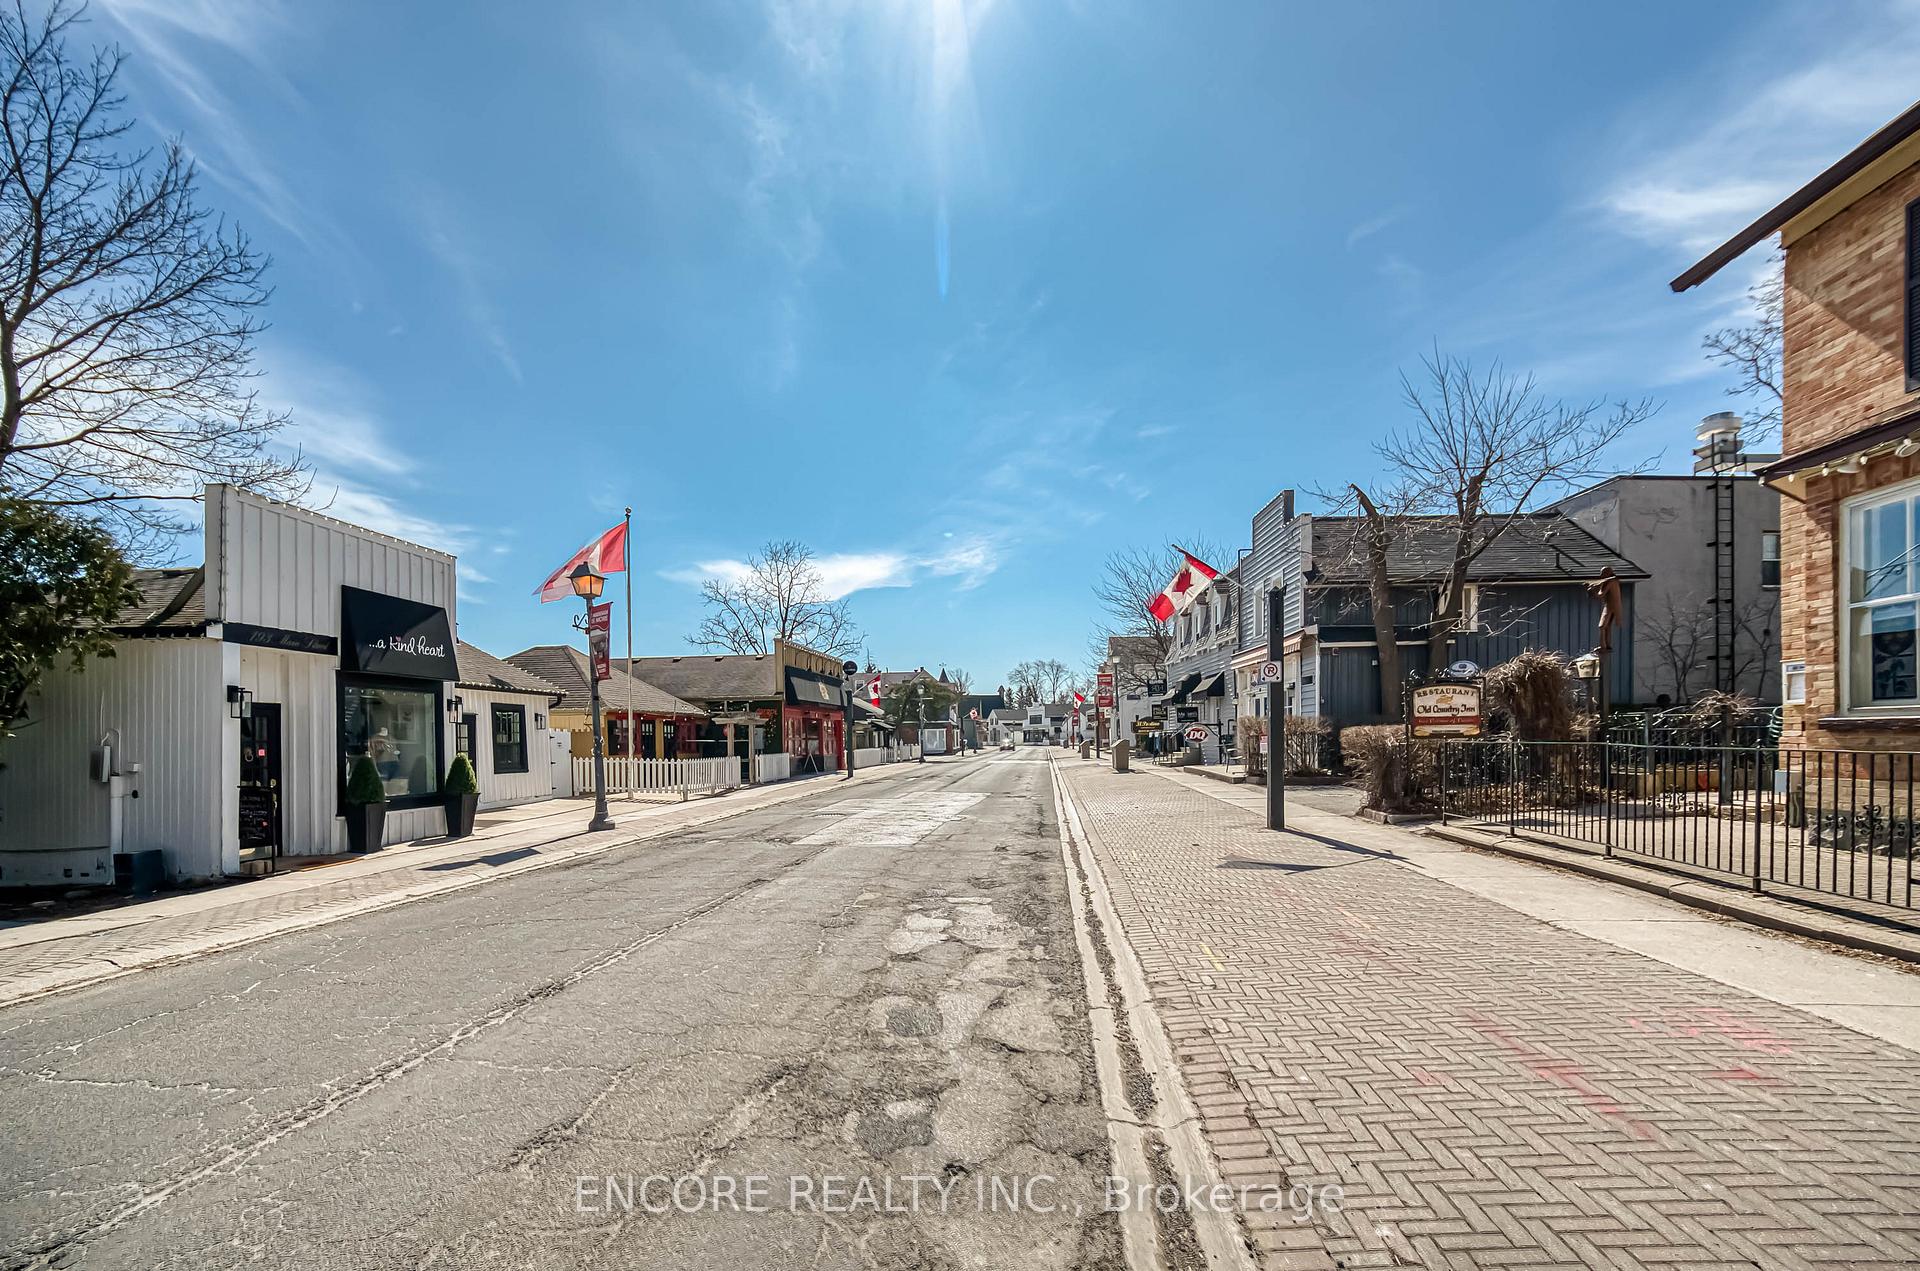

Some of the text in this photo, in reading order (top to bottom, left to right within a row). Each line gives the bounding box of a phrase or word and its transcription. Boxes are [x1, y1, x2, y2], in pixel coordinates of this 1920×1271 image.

[389, 636, 417, 656] kind
[416, 635, 445, 657] heart
[1417, 688, 1474, 698] RESTAURANT
[1417, 704, 1475, 716] Old Country Inn
[1189, 730, 1206, 740] DQ
